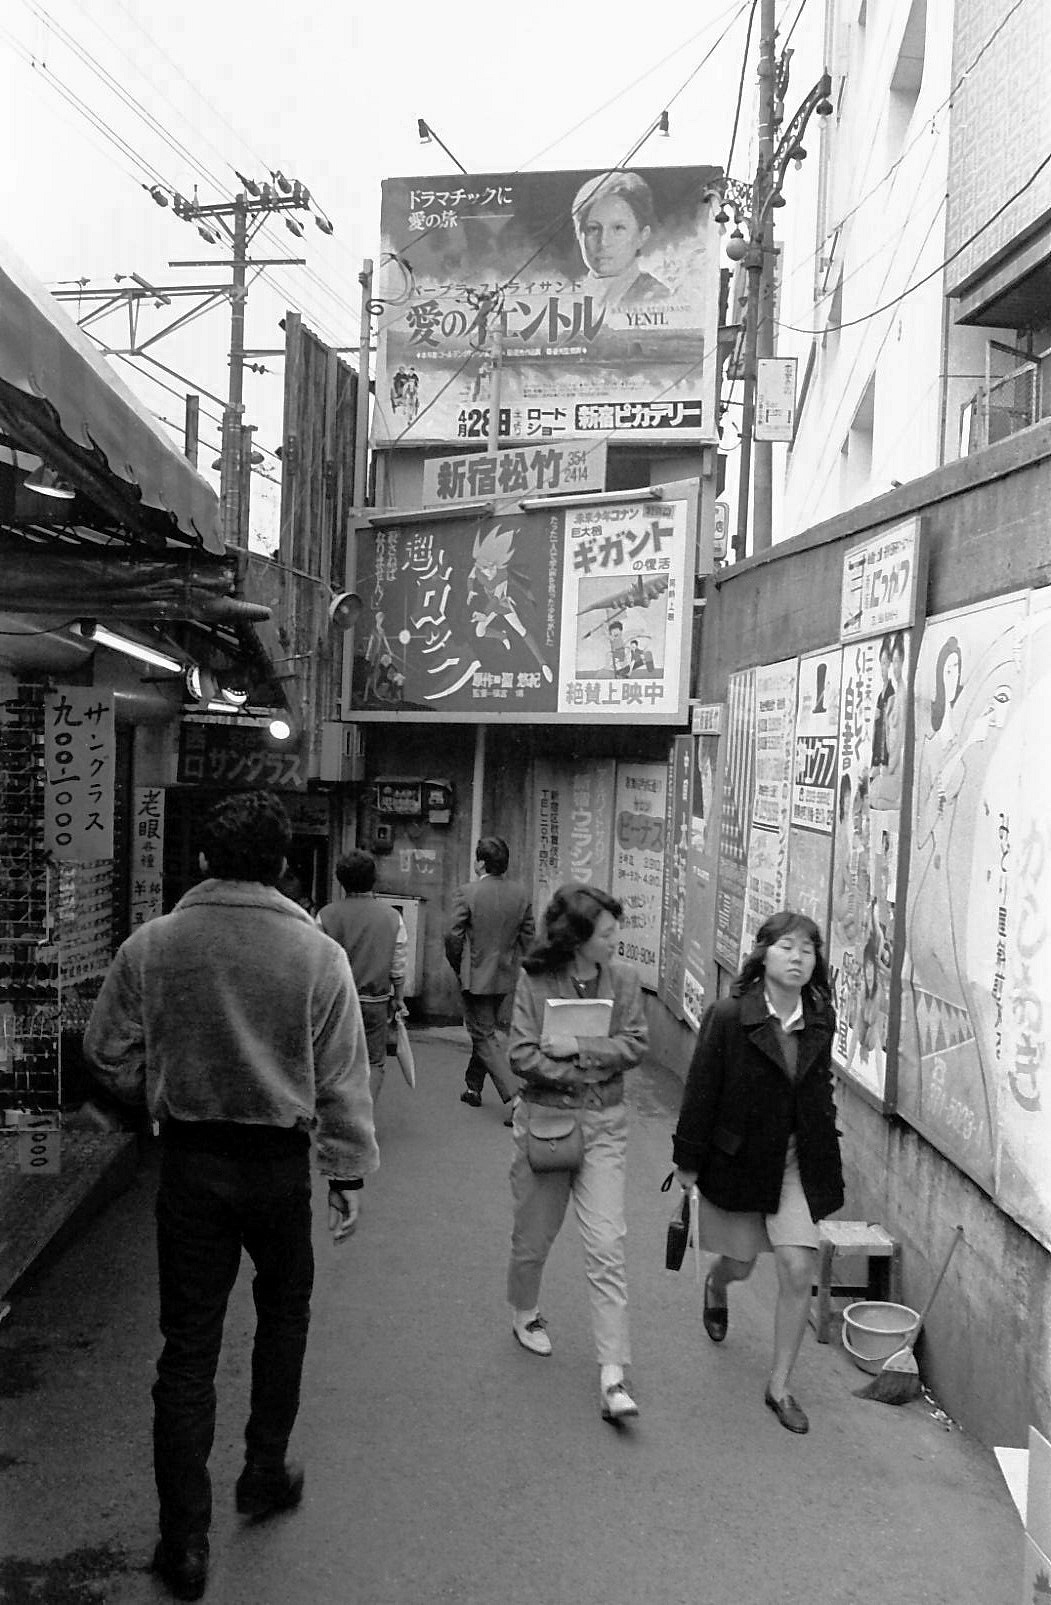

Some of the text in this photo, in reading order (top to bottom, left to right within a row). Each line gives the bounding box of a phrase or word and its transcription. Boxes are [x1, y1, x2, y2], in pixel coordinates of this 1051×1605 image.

[410, 187, 513, 210] ドラマチックに
[408, 210, 458, 231] 愛の旅
[626, 312, 669, 326] YENTL
[528, 408, 567, 420] ロード
[578, 402, 701, 430] 新宿ピカデリー
[527, 423, 566, 436] ショー
[567, 450, 586, 467] 354
[437, 448, 563, 500] 新宿松竹
[574, 521, 674, 574] ギガント
[632, 557, 671, 571] の復活
[566, 681, 664, 705] 絶賛上映中
[84, 702, 110, 831] サングラス
